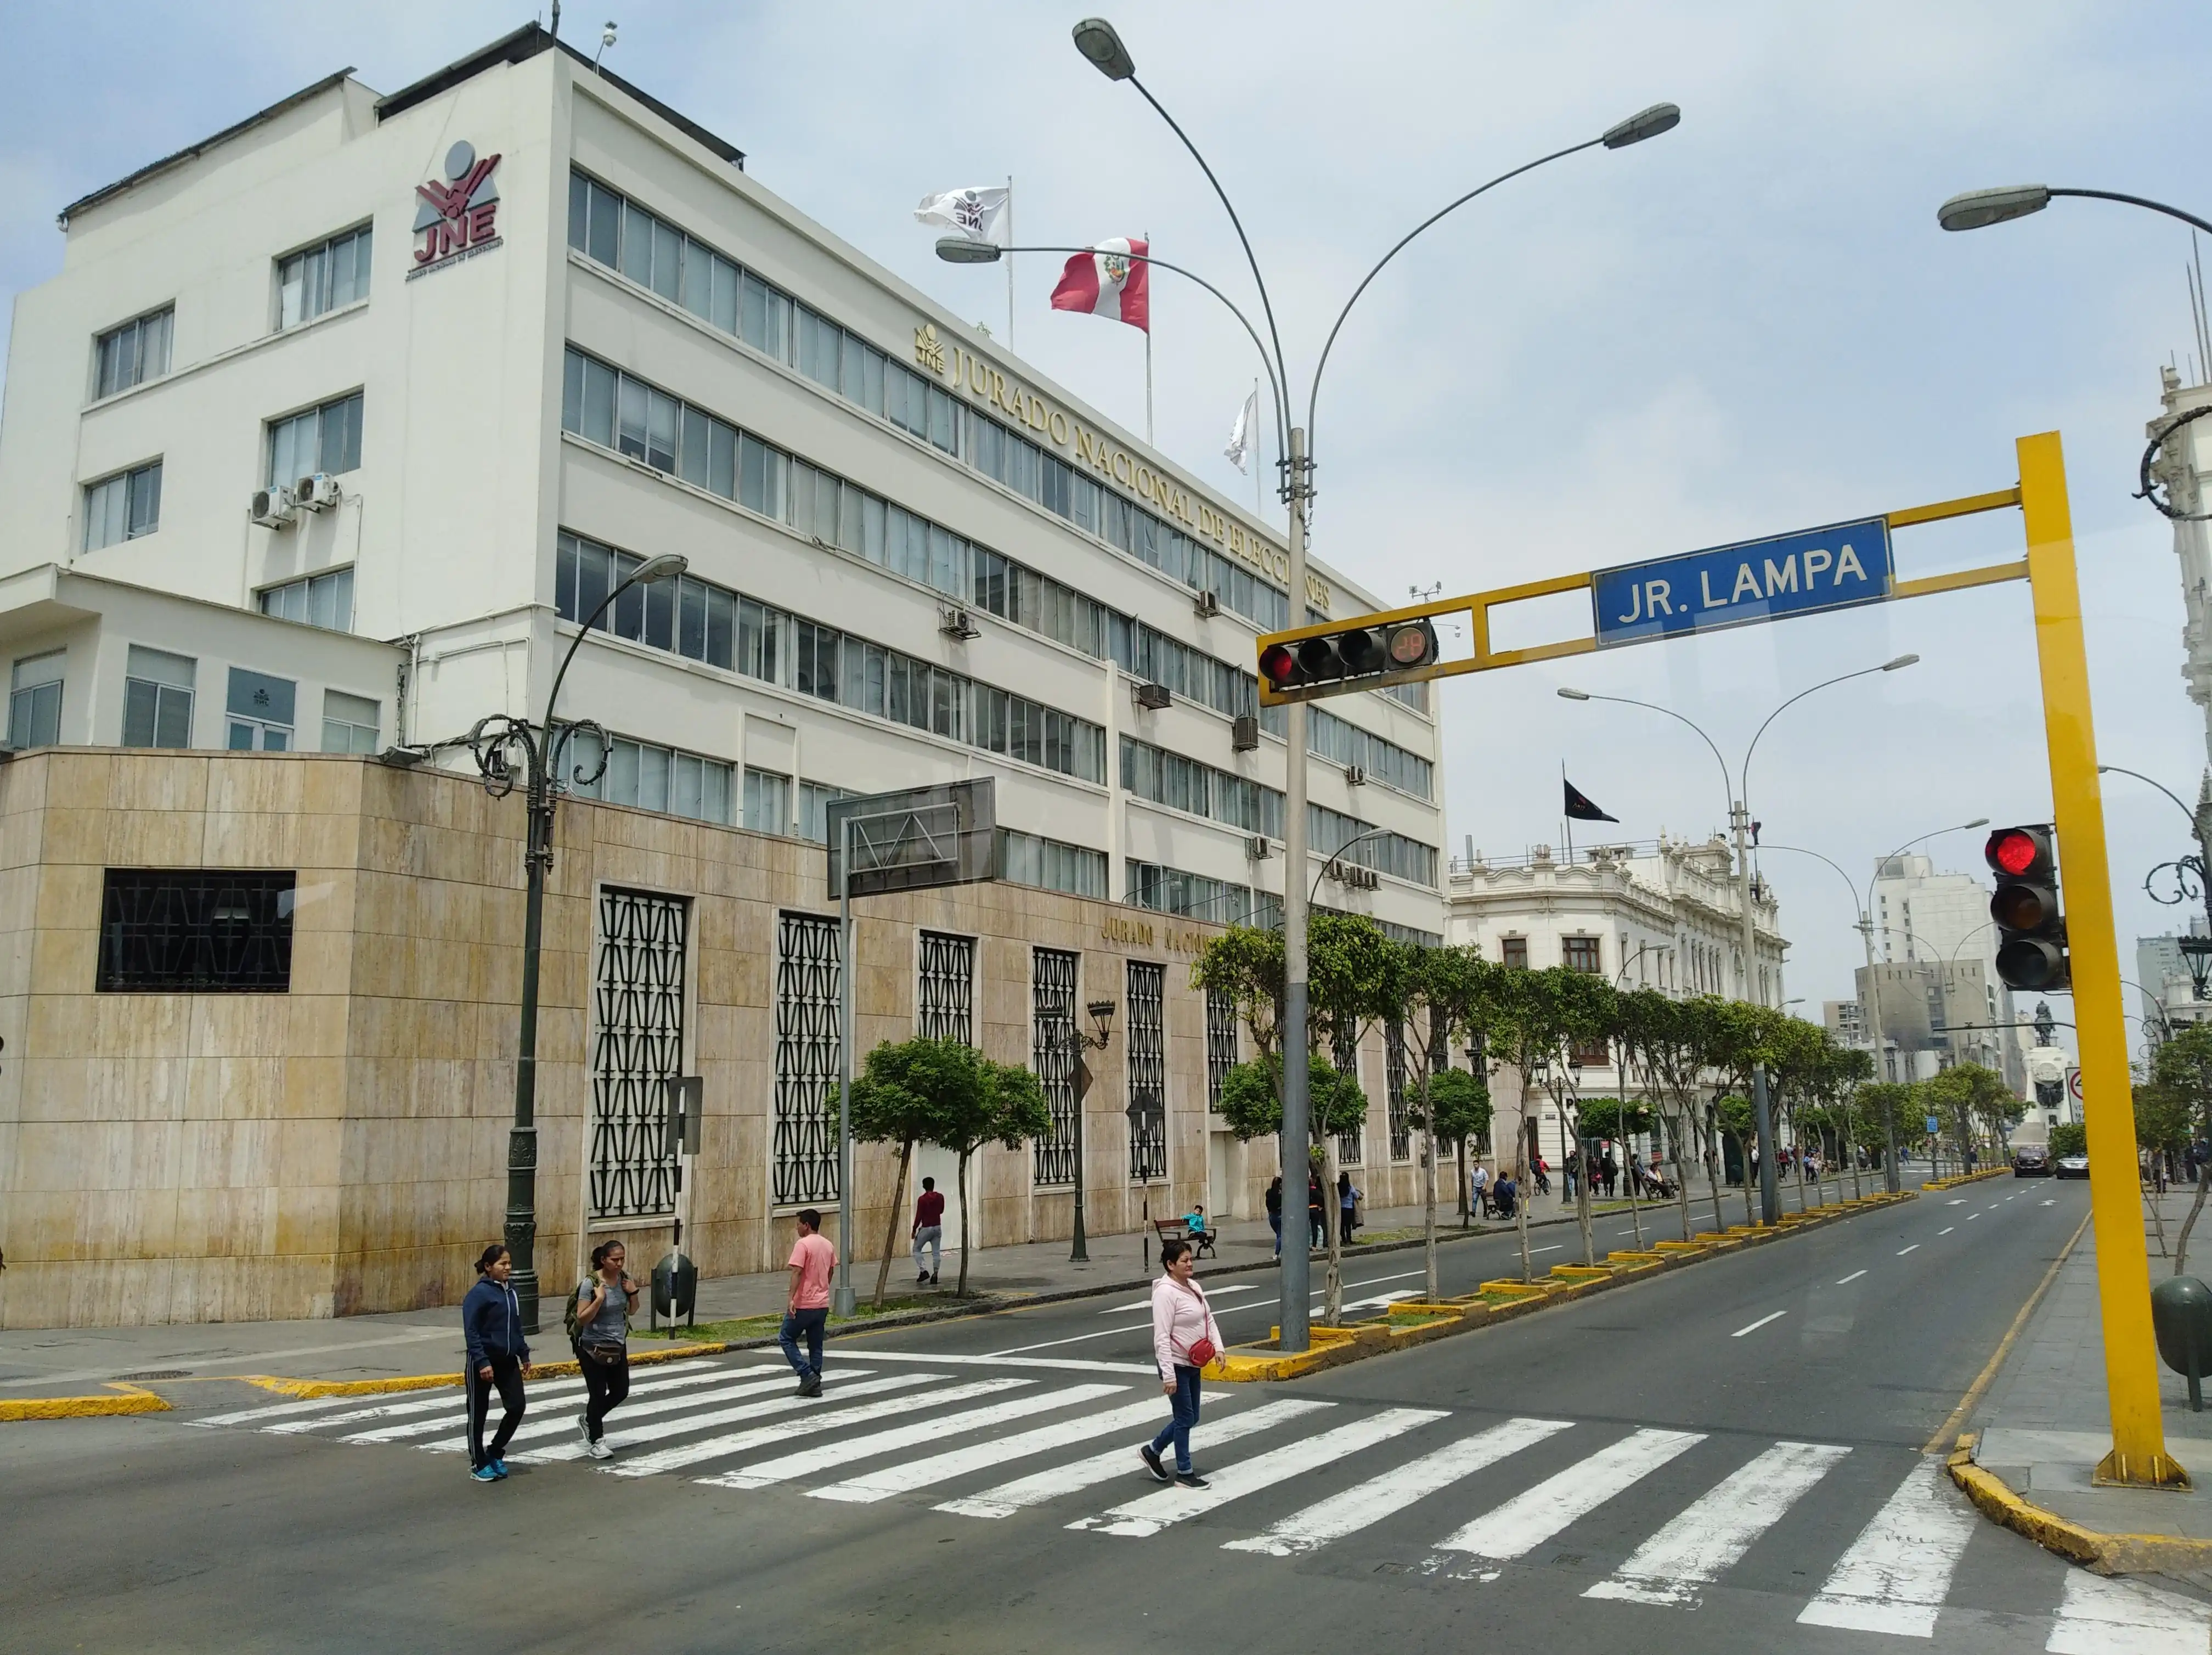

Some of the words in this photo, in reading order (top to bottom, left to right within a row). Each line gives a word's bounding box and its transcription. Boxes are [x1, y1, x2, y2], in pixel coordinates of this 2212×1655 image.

[414, 203, 496, 262] JNE
[916, 348, 945, 376] JNE
[952, 347, 1068, 445] JURADO
[1074, 425, 1194, 526] NACIONAL
[1199, 505, 1224, 545] DE
[1229, 525, 1329, 609] ELECCINES
[1618, 579, 1688, 624] JR.
[1701, 544, 1867, 609] LAMPA
[1101, 917, 1154, 945] JURADO
[1164, 926, 1210, 956] NACION
